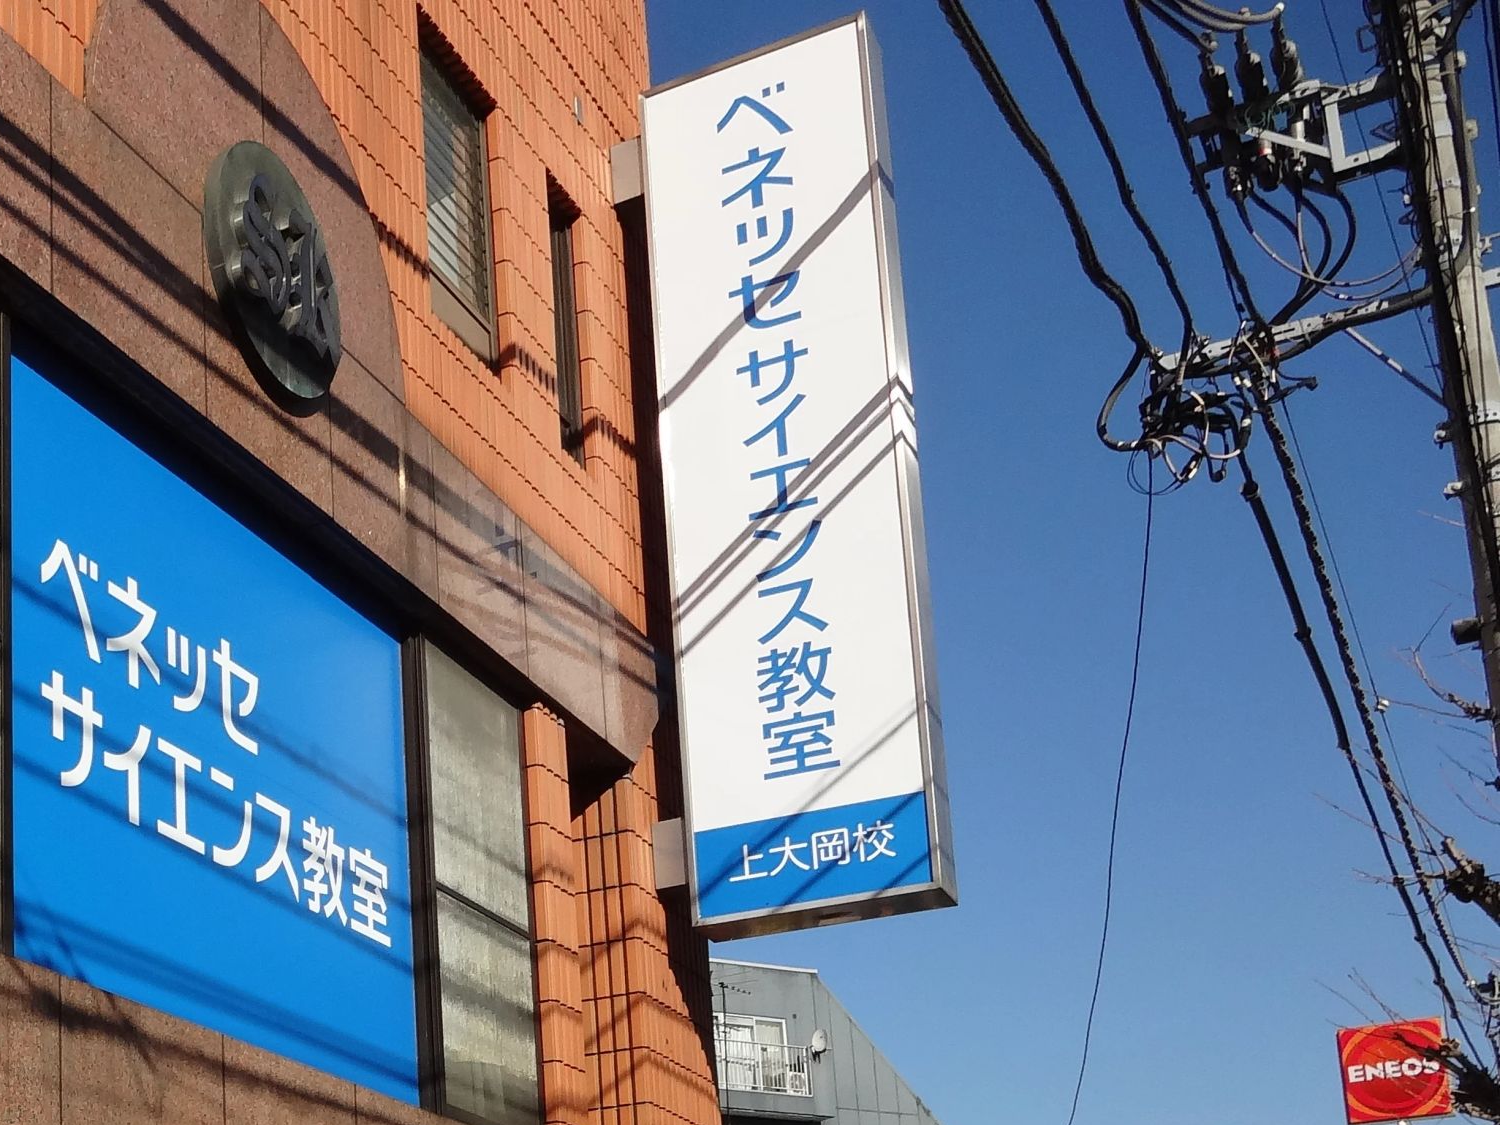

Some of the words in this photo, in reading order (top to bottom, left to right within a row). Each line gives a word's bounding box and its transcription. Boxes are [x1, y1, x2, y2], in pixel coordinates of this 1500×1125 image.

[40, 539, 260, 756] ベネッセ
[40, 668, 392, 949] サイエンス教室
[729, 819, 897, 884] 上大岡校
[1347, 1056, 1440, 1083] ENEOS
